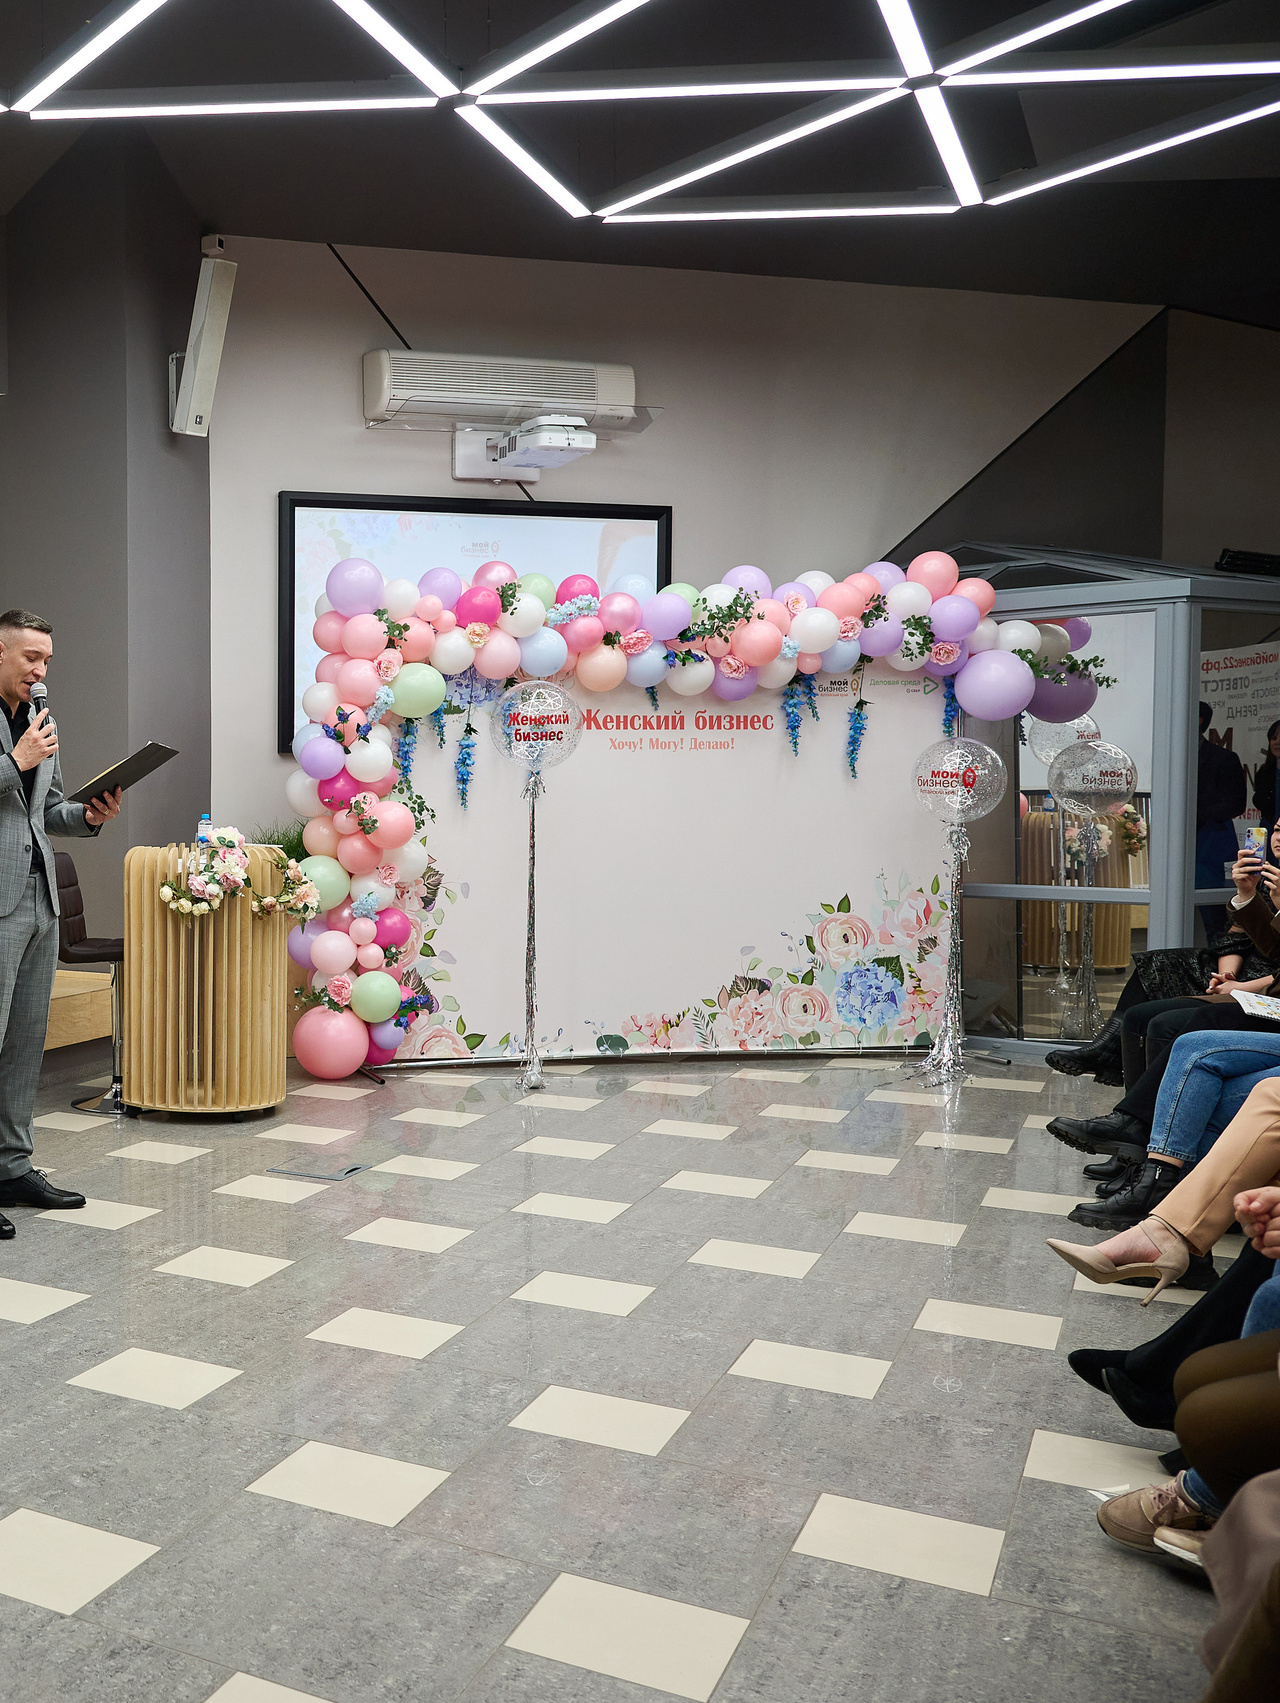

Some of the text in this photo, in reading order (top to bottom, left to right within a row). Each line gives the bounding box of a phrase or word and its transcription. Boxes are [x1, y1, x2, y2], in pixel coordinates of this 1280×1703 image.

[818, 684, 848, 692] бизнес
[869, 678, 899, 686] Деловая
[508, 710, 570, 727] Женский
[577, 709, 775, 731] Женский бизнес
[514, 728, 563, 742] бизнес
[608, 737, 735, 752] Хочу! Могу! Делаю!
[917, 775, 958, 788] бизнес
[1082, 774, 1123, 786] бизнес
